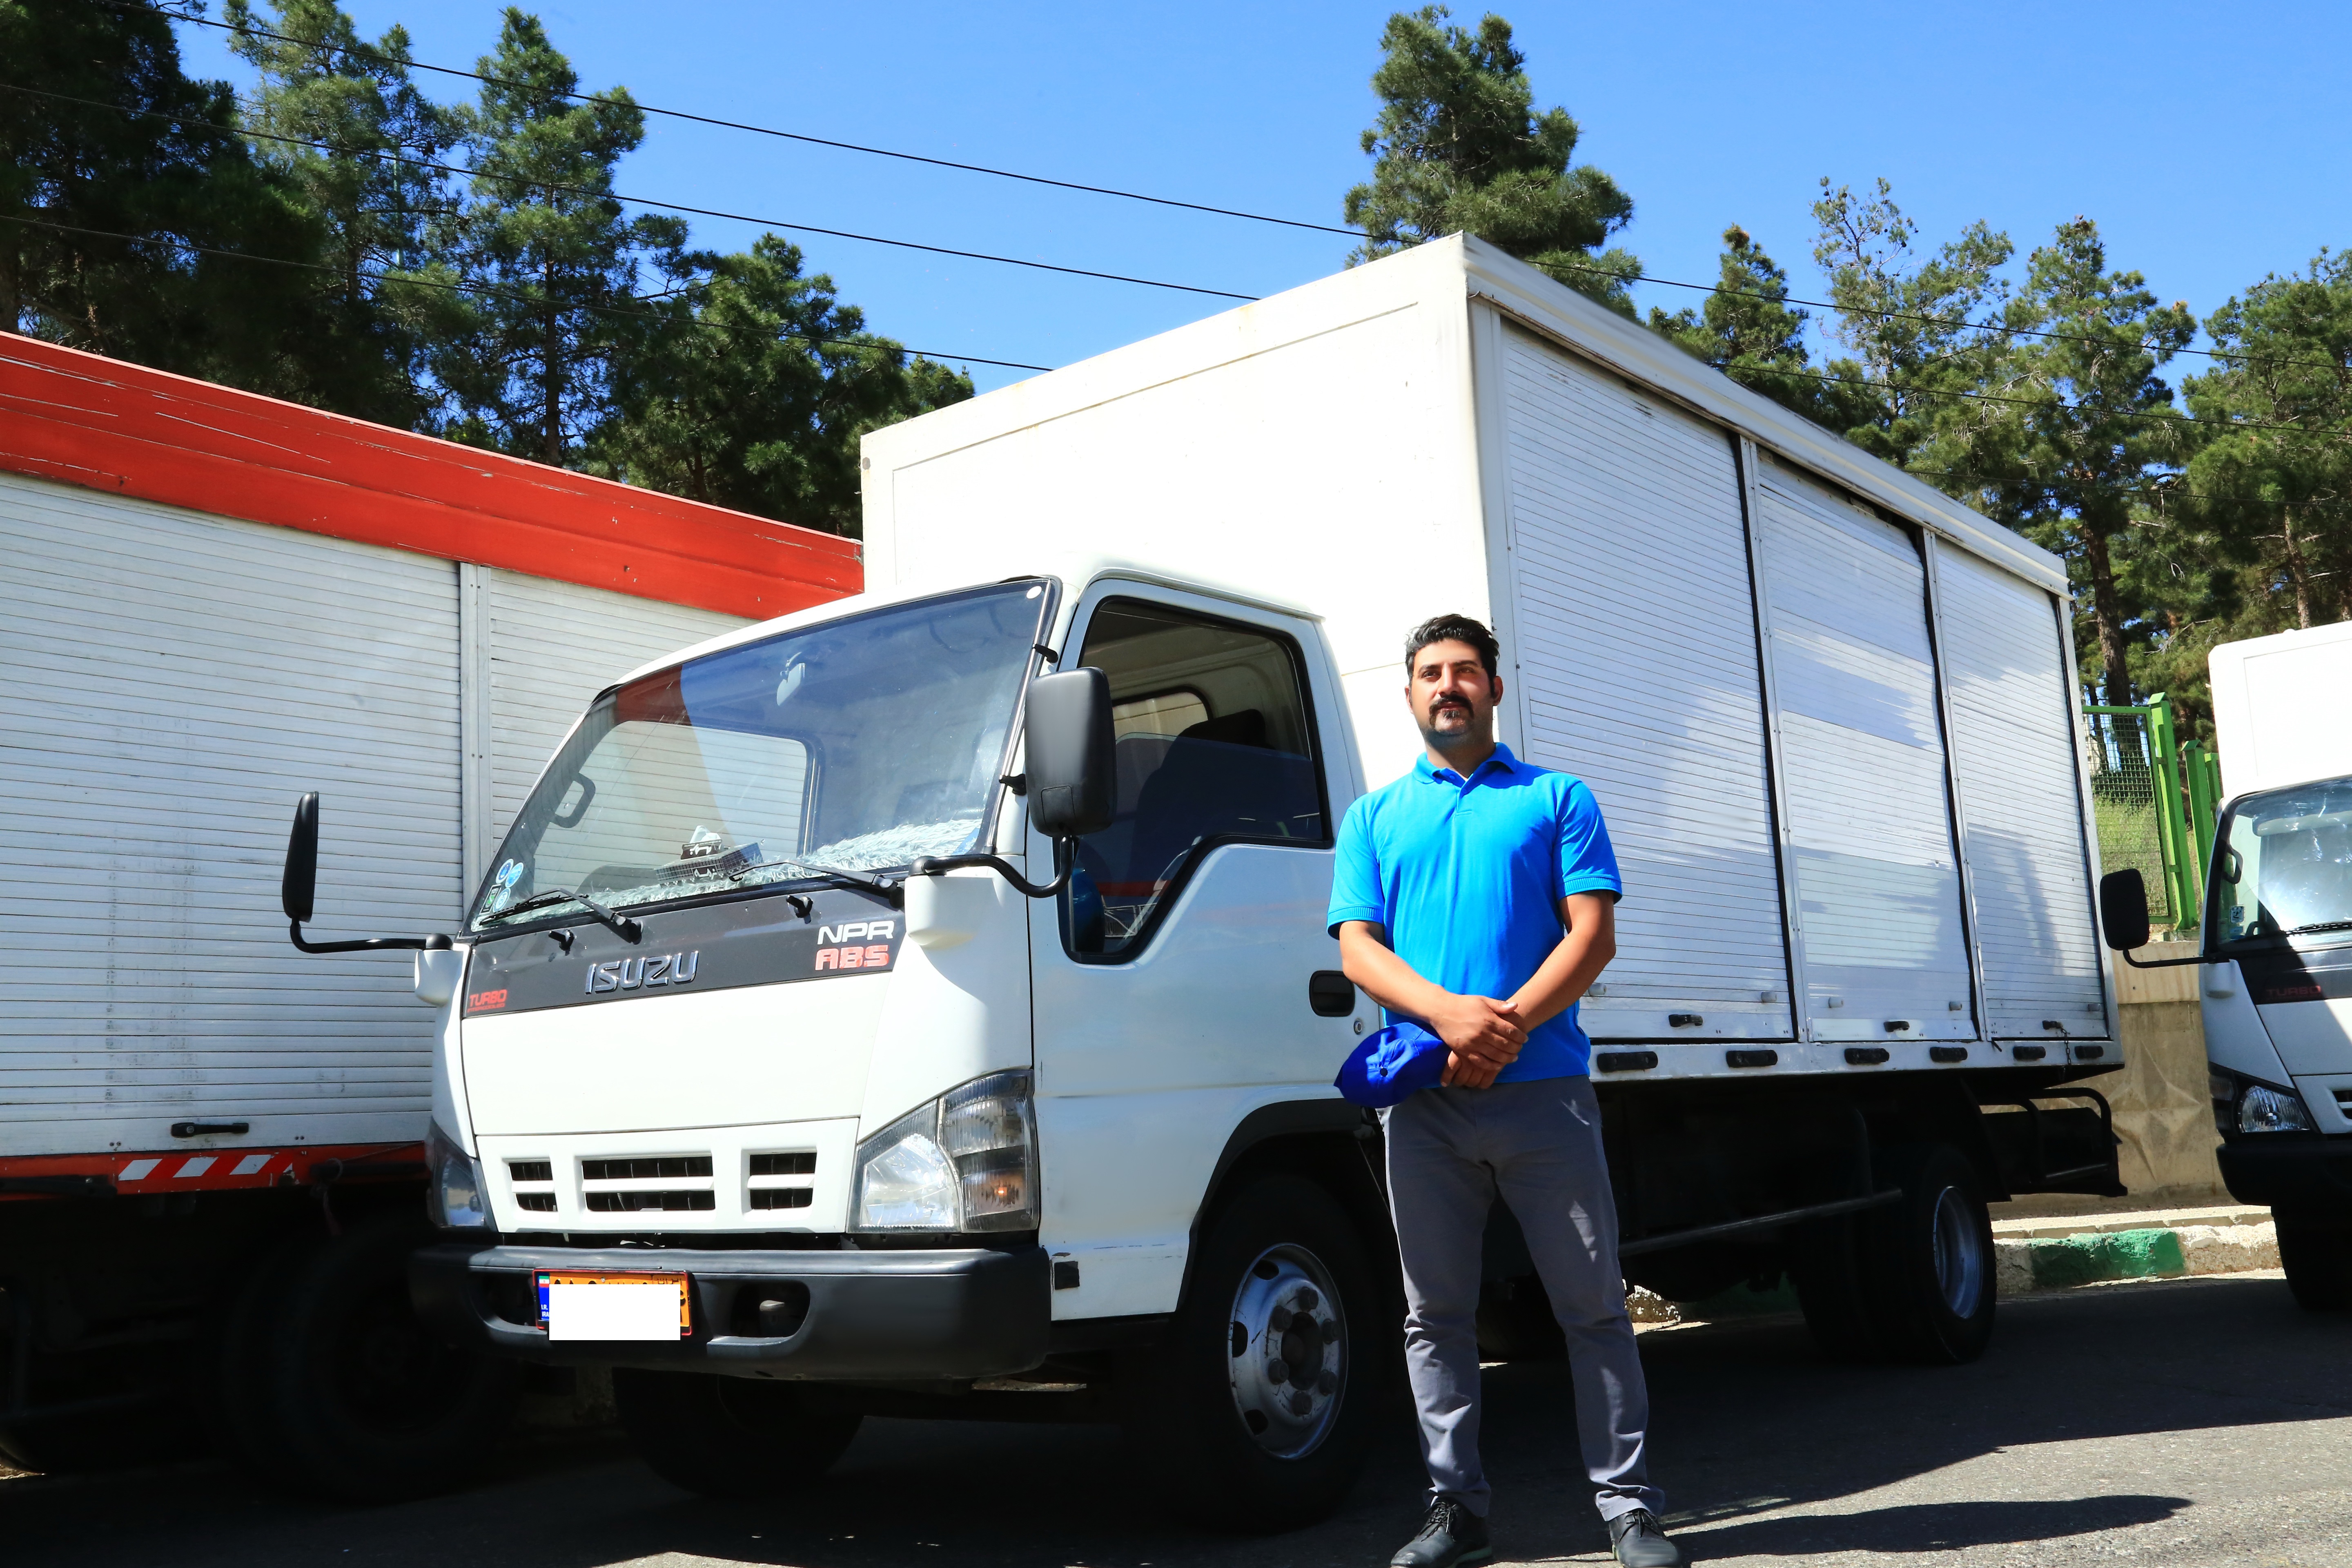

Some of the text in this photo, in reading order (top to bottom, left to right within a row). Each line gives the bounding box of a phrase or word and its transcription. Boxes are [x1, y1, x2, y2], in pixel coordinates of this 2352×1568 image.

[817, 920, 894, 945] NPR
[815, 944, 889, 970] ABS
[585, 950, 699, 995] ISUZU
[469, 989, 507, 1007] TURBO
[2267, 985, 2321, 996] TURBO
